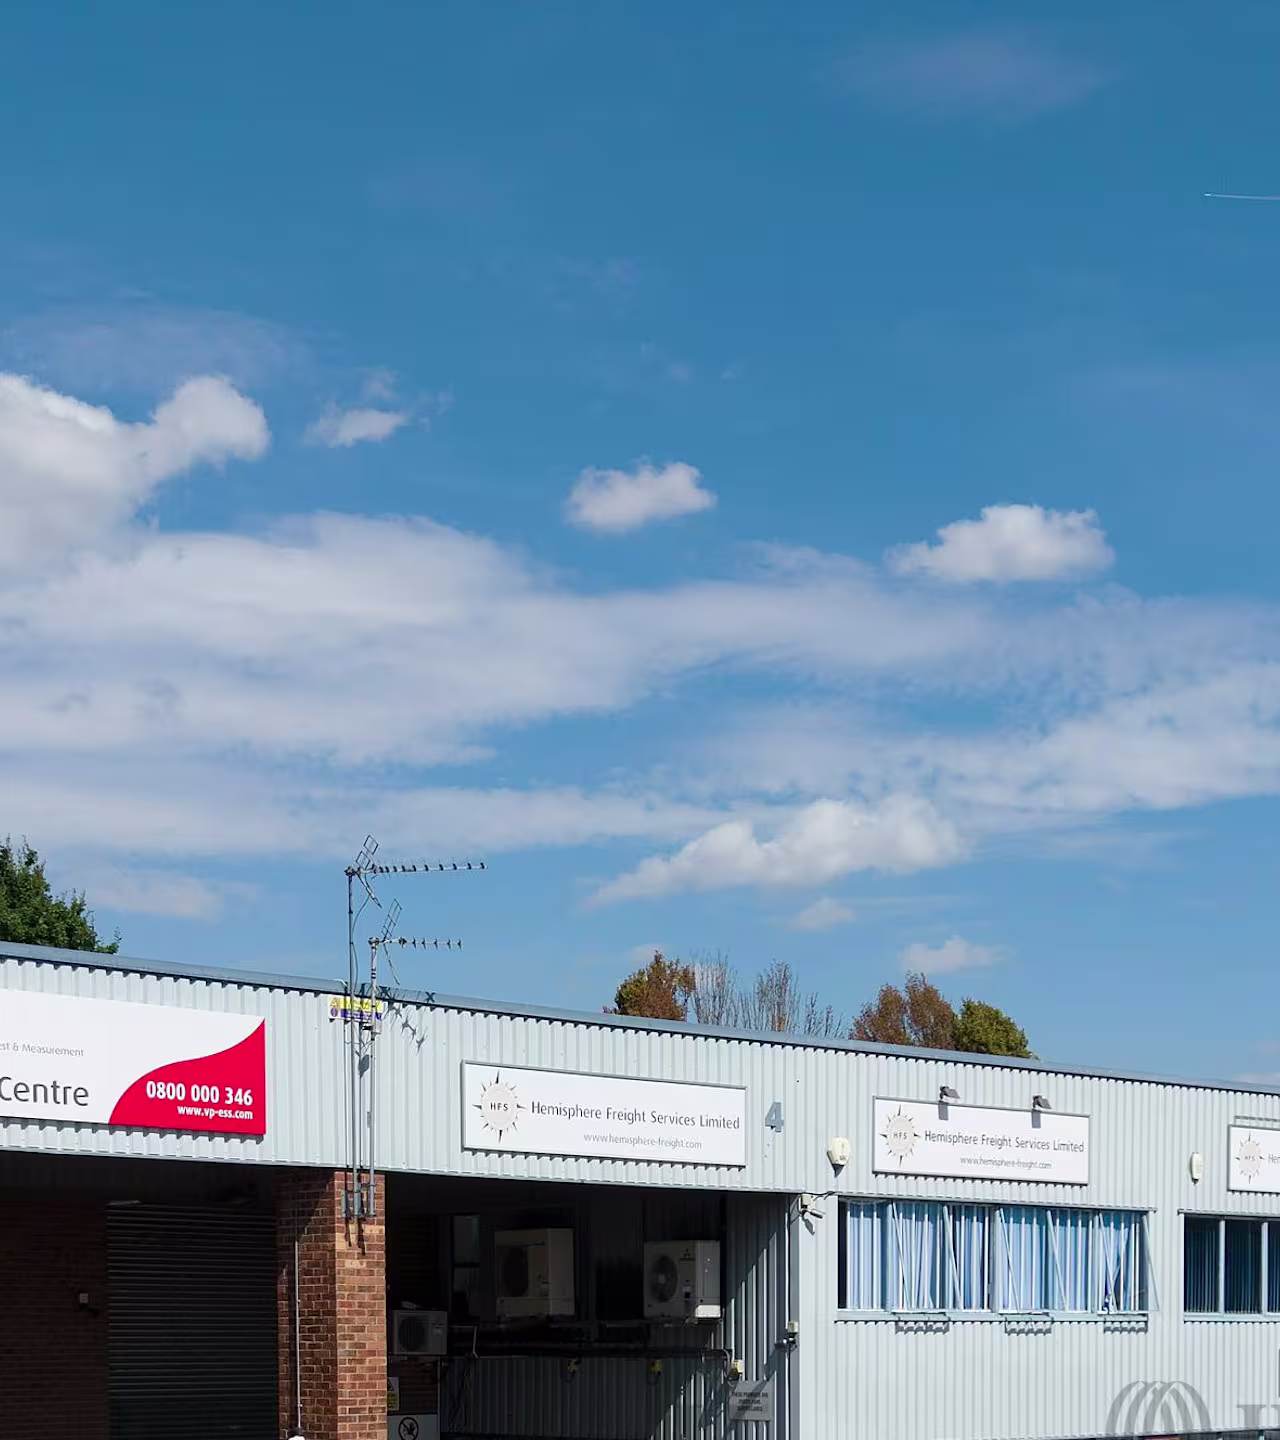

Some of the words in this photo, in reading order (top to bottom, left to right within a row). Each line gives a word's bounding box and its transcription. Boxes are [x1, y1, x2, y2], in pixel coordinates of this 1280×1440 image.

[12, 1043, 19, 1052] &
[21, 1043, 84, 1057] Measurement
[145, 1080, 186, 1101] 0800
[190, 1083, 220, 1104] 000
[224, 1086, 253, 1106] 346
[176, 1105, 254, 1120] www.vp-ess.com
[530, 1100, 602, 1120] Hemisphere
[606, 1106, 646, 1125] Freight
[650, 1110, 696, 1127] Services
[699, 1114, 740, 1130] Limited
[764, 1100, 785, 1134] 4
[583, 1132, 702, 1150] www.hemisphere-freight.com
[924, 1129, 978, 1146] Hemisphere
[981, 1134, 1012, 1150] Freight
[1015, 1136, 1050, 1151] Services
[1053, 1140, 1084, 1153] Limited
